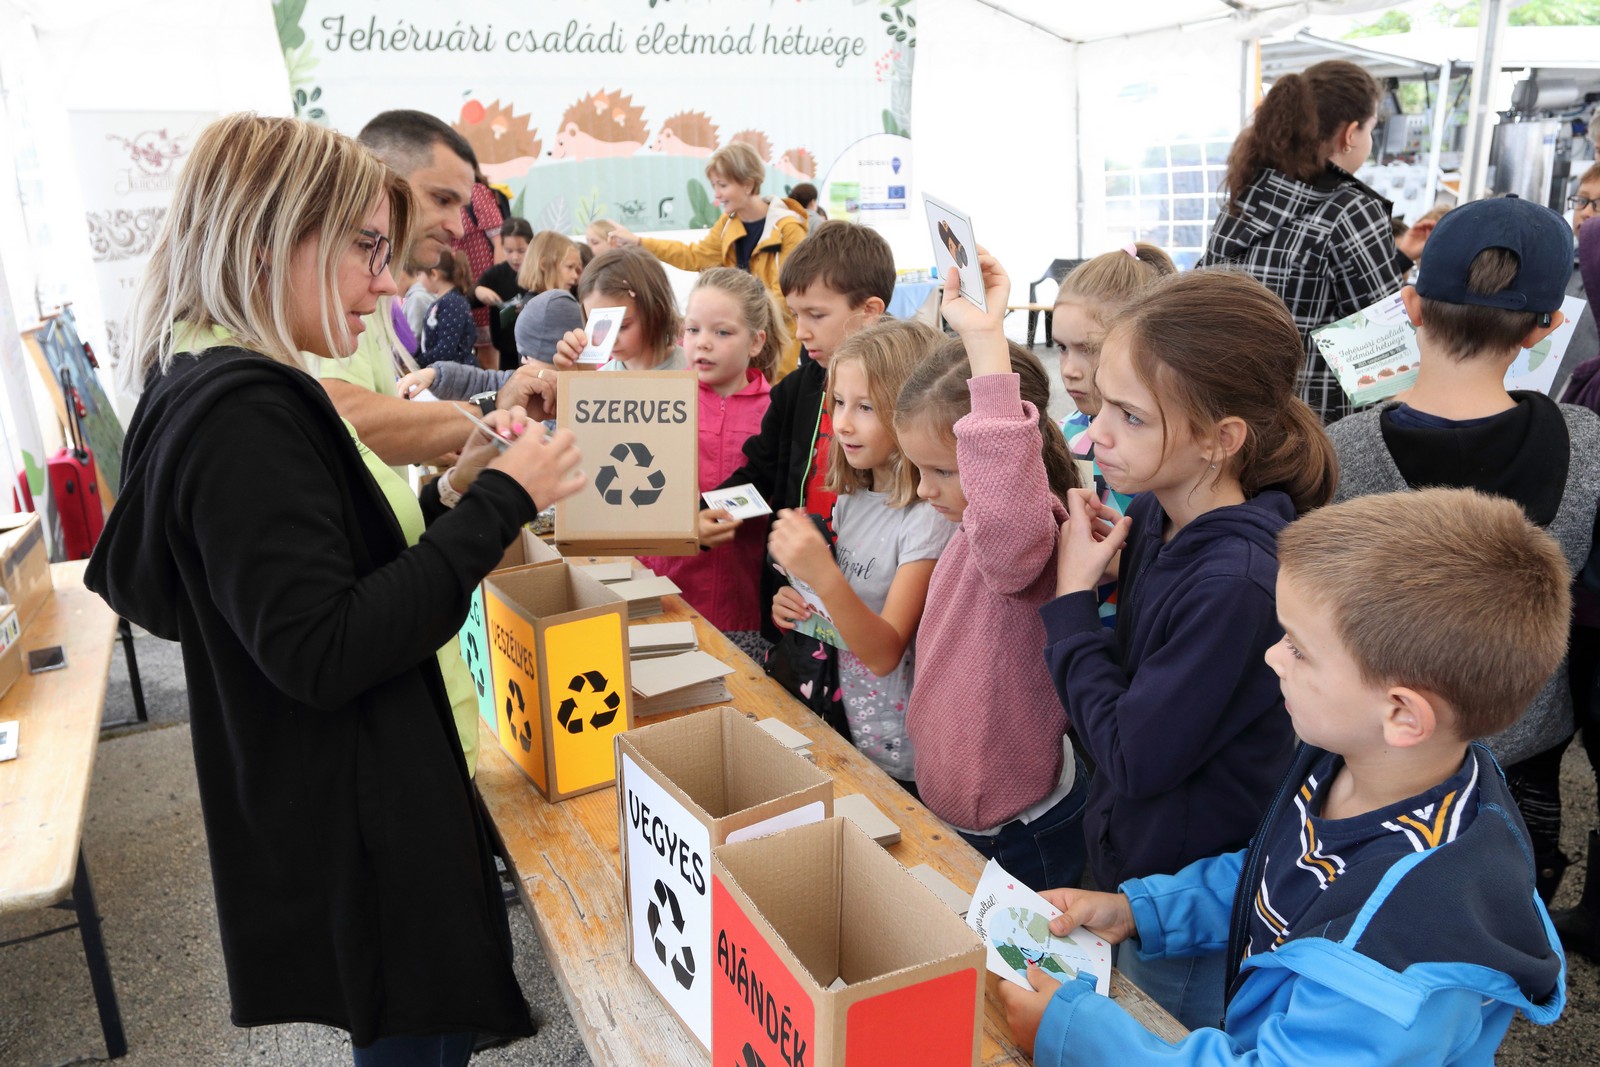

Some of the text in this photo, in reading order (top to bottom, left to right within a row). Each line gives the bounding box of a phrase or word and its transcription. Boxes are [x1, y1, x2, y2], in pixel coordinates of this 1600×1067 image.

[321, 15, 866, 68] Fehérvári családi életmód hétvége
[575, 400, 687, 424] SZERVES
[848, 557, 876, 583] girl
[491, 619, 534, 680] VESZÉLYES
[629, 789, 705, 896] VEGYES
[718, 929, 807, 1067] AJÁNDÉK
